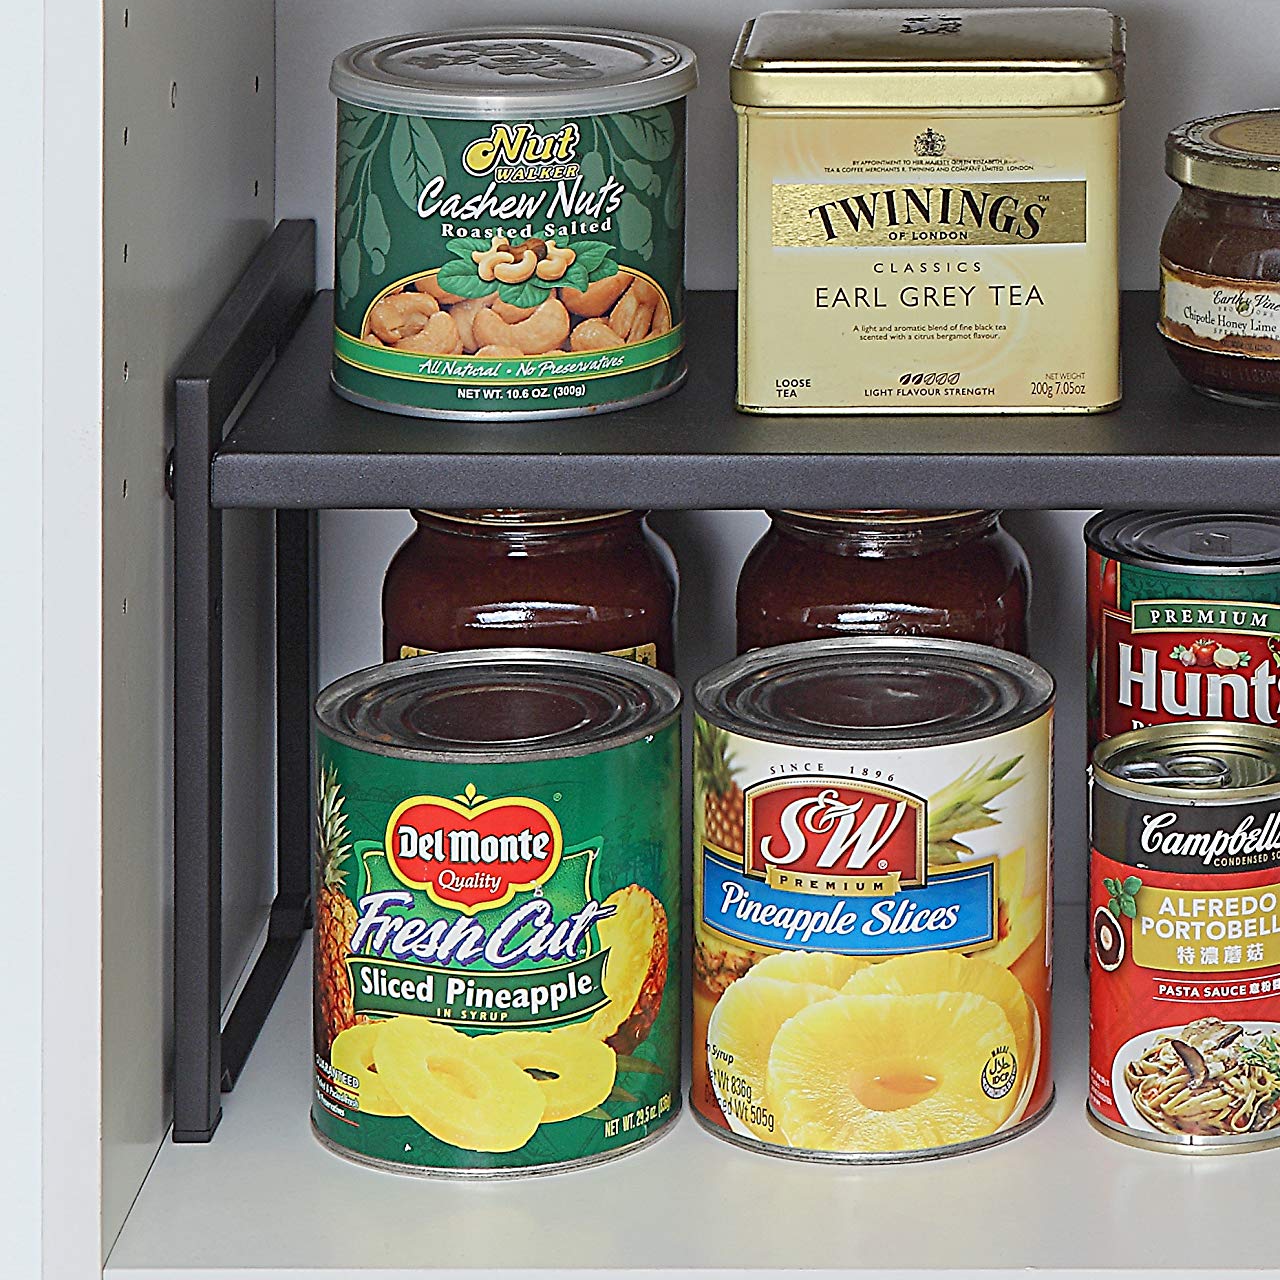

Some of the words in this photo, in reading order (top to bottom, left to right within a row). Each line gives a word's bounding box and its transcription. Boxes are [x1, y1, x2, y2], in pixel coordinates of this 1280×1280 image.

[463, 124, 580, 176] Nut
[496, 164, 579, 183] WALKER
[417, 176, 547, 220] Cashew
[549, 175, 625, 220] Nuts
[809, 188, 1046, 241] TWININGS
[441, 223, 532, 239] Roasted
[544, 218, 612, 237] Salted
[888, 232, 906, 240] OF
[912, 231, 968, 240] LONDON
[874, 262, 982, 273] CLASSICS
[816, 287, 886, 308] EARL
[900, 286, 975, 307] GREY
[989, 285, 1044, 306] TEA
[1213, 290, 1245, 305] Earth
[861, 325, 877, 333] light
[1184, 306, 1215, 325] Chipotle
[1218, 314, 1248, 330] Honey
[1250, 318, 1277, 332] Lime
[936, 333, 971, 342] bergamot
[418, 359, 440, 374] All
[441, 360, 498, 377] Natural
[516, 363, 535, 376] No
[538, 355, 625, 376] Preservatives
[1063, 372, 1086, 380] WEIGHT
[458, 388, 480, 399] NET
[482, 389, 502, 399] WT.
[506, 389, 529, 399] 10.6
[553, 384, 586, 399] (300g)
[776, 379, 811, 388] LOOSE
[776, 389, 798, 398] TEA
[864, 389, 893, 397] LIGHT
[896, 388, 941, 396] FLAVOUR
[944, 387, 995, 396] STRENGTH
[1031, 382, 1053, 398] 200g
[1055, 382, 1086, 395] 7.05oz
[1150, 609, 1268, 628] PREMIUM
[770, 763, 824, 774] SINCE
[849, 766, 895, 782] 1896
[761, 789, 907, 869] S&W
[398, 826, 443, 861] Del
[450, 828, 550, 864] Monte
[1214, 854, 1268, 867] CONDENSED
[438, 869, 501, 892] Quality
[780, 875, 884, 891] PREMIUM
[720, 881, 857, 942] Pineapple
[863, 900, 960, 936] Slices
[1159, 893, 1277, 917] ALFREDO
[351, 893, 484, 962] Fresh
[486, 898, 616, 964] Cut
[1177, 943, 1264, 965] 特濃蘑菇
[360, 967, 433, 1003] Sliced
[447, 971, 593, 1014] Pineapple
[1159, 985, 1200, 997] PASTA
[1204, 985, 1246, 997] SAUCE
[437, 1007, 451, 1018] IN
[461, 1010, 508, 1021] SYRUP
[712, 1044, 734, 1065] Syrup
[717, 1069, 729, 1092] Wt
[731, 1076, 752, 1104] 836g
[605, 1118, 619, 1138] NET
[623, 1113, 635, 1131] WT.
[636, 1106, 650, 1127] 29.5
[735, 1099, 748, 1121] Wt
[750, 1106, 774, 1132] 505g
